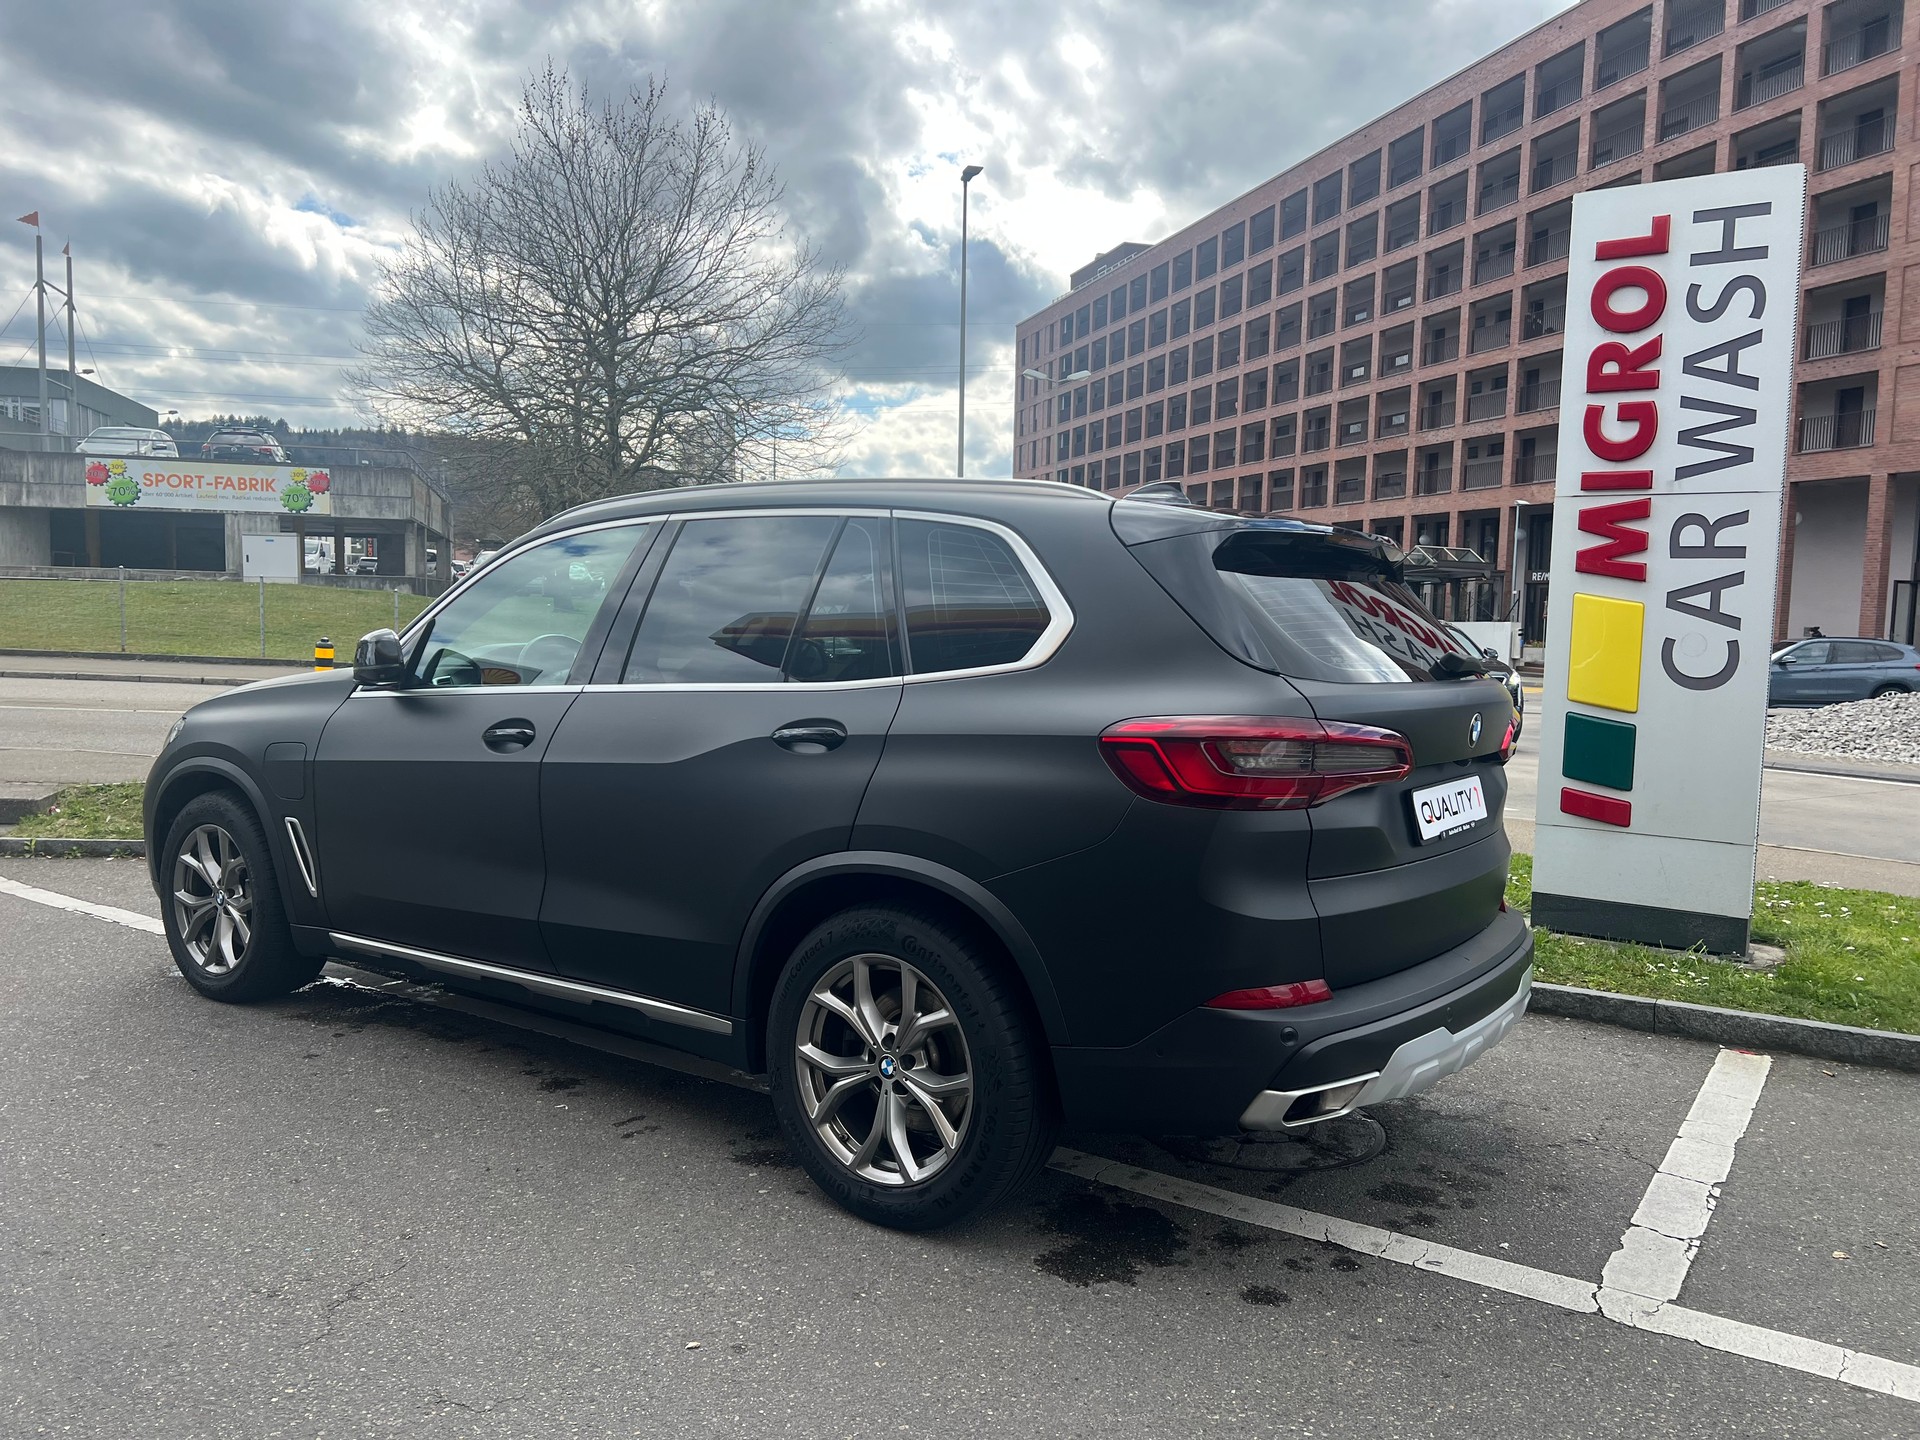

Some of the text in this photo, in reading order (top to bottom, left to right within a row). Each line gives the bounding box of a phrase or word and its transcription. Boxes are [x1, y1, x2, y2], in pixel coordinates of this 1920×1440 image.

[1575, 214, 1671, 582] MIGROL
[1661, 201, 1773, 691] CAR WASH
[111, 486, 136, 497] 70%
[142, 472, 277, 492] SPORT-FABRIK
[285, 493, 308, 504] 70%
